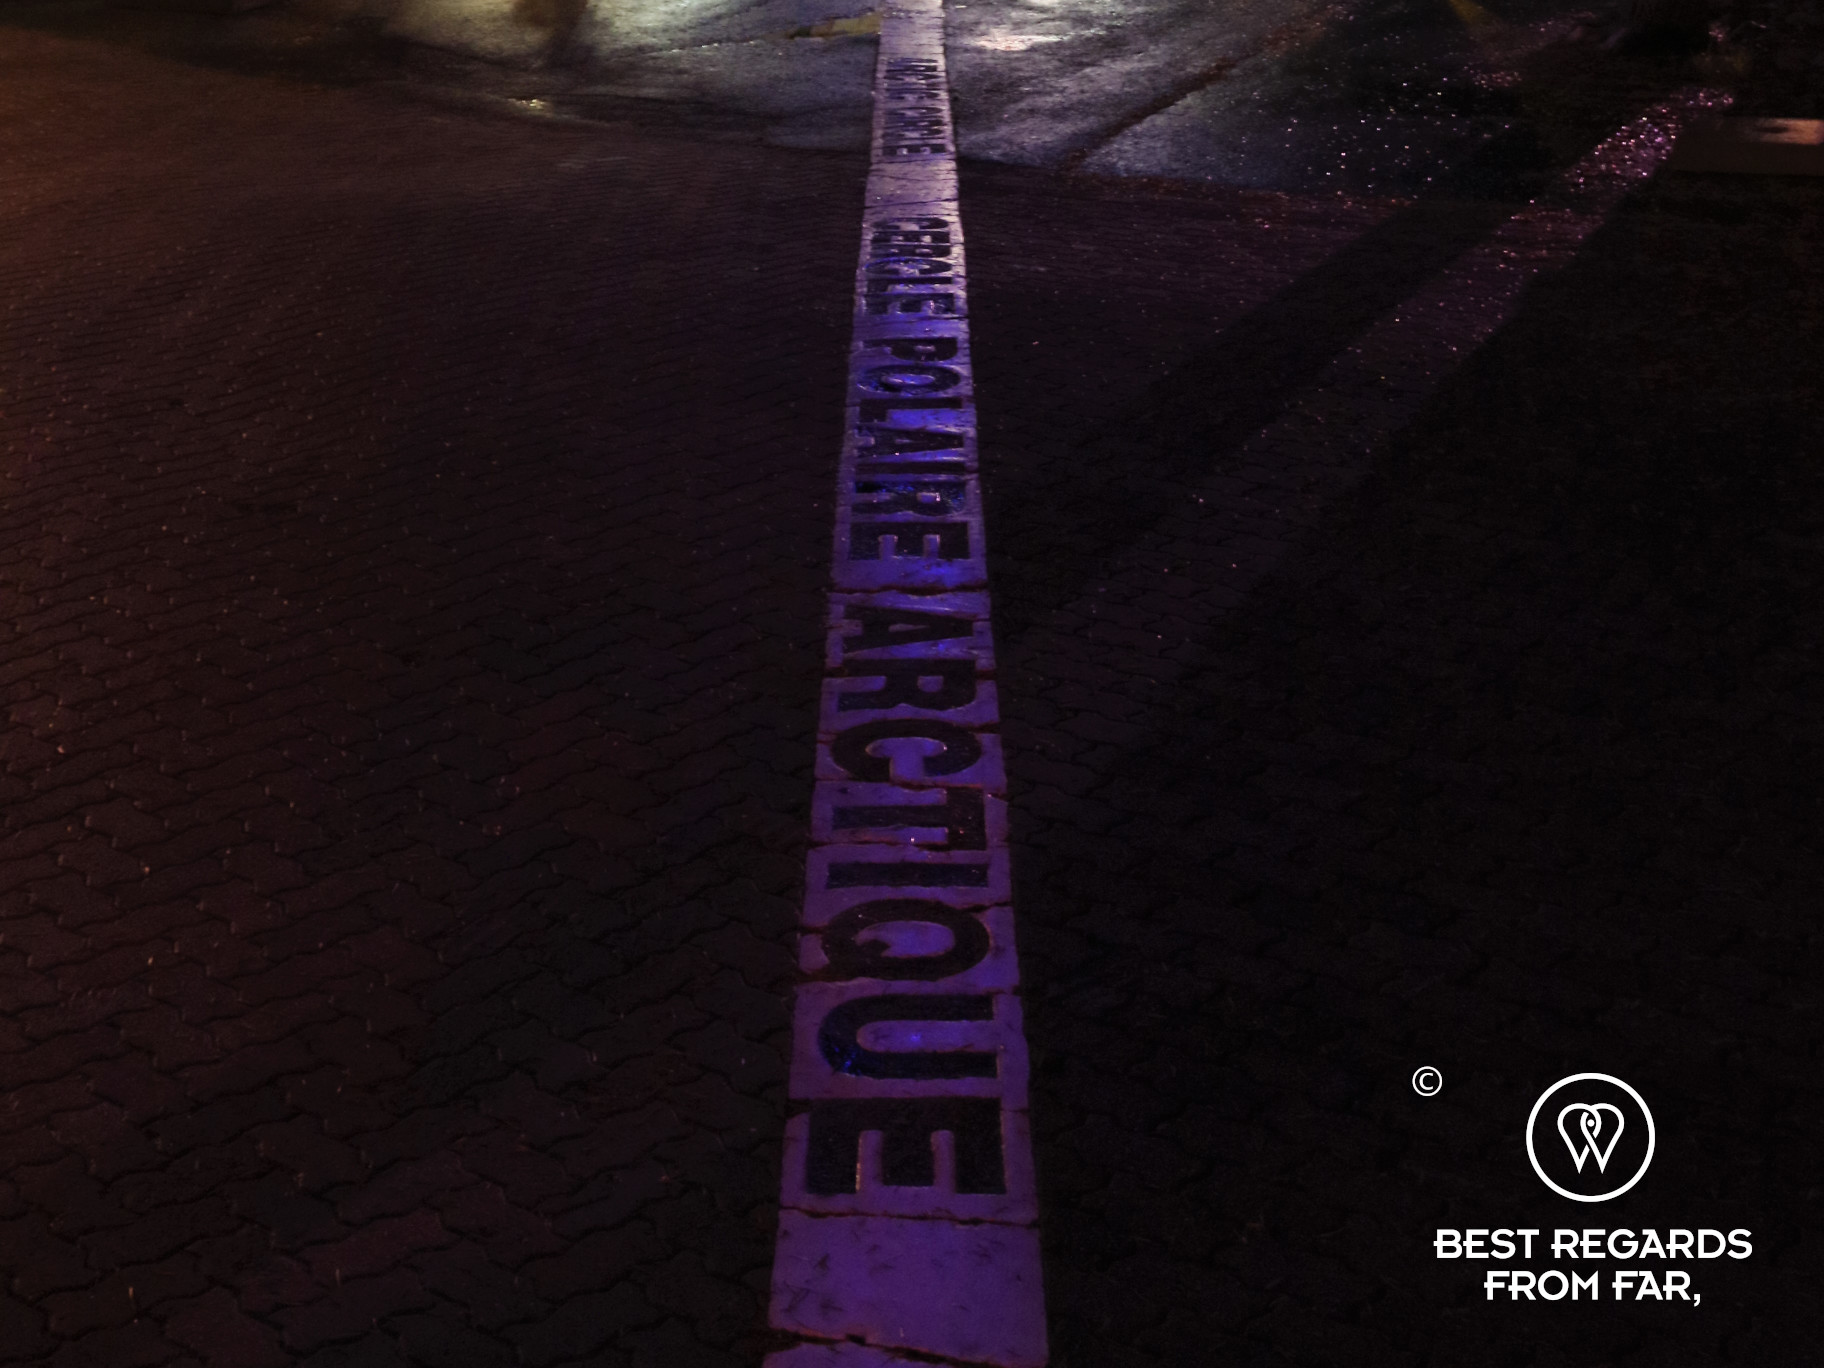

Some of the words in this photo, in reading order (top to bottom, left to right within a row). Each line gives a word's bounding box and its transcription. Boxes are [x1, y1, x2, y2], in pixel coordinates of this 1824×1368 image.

[884, 57, 943, 100] ARCTIC
[882, 105, 946, 156] CIRCLE
[864, 217, 955, 316] CERCLE
[848, 336, 971, 562] POLAIRE
[805, 604, 1008, 1196] ARCTIQUE
